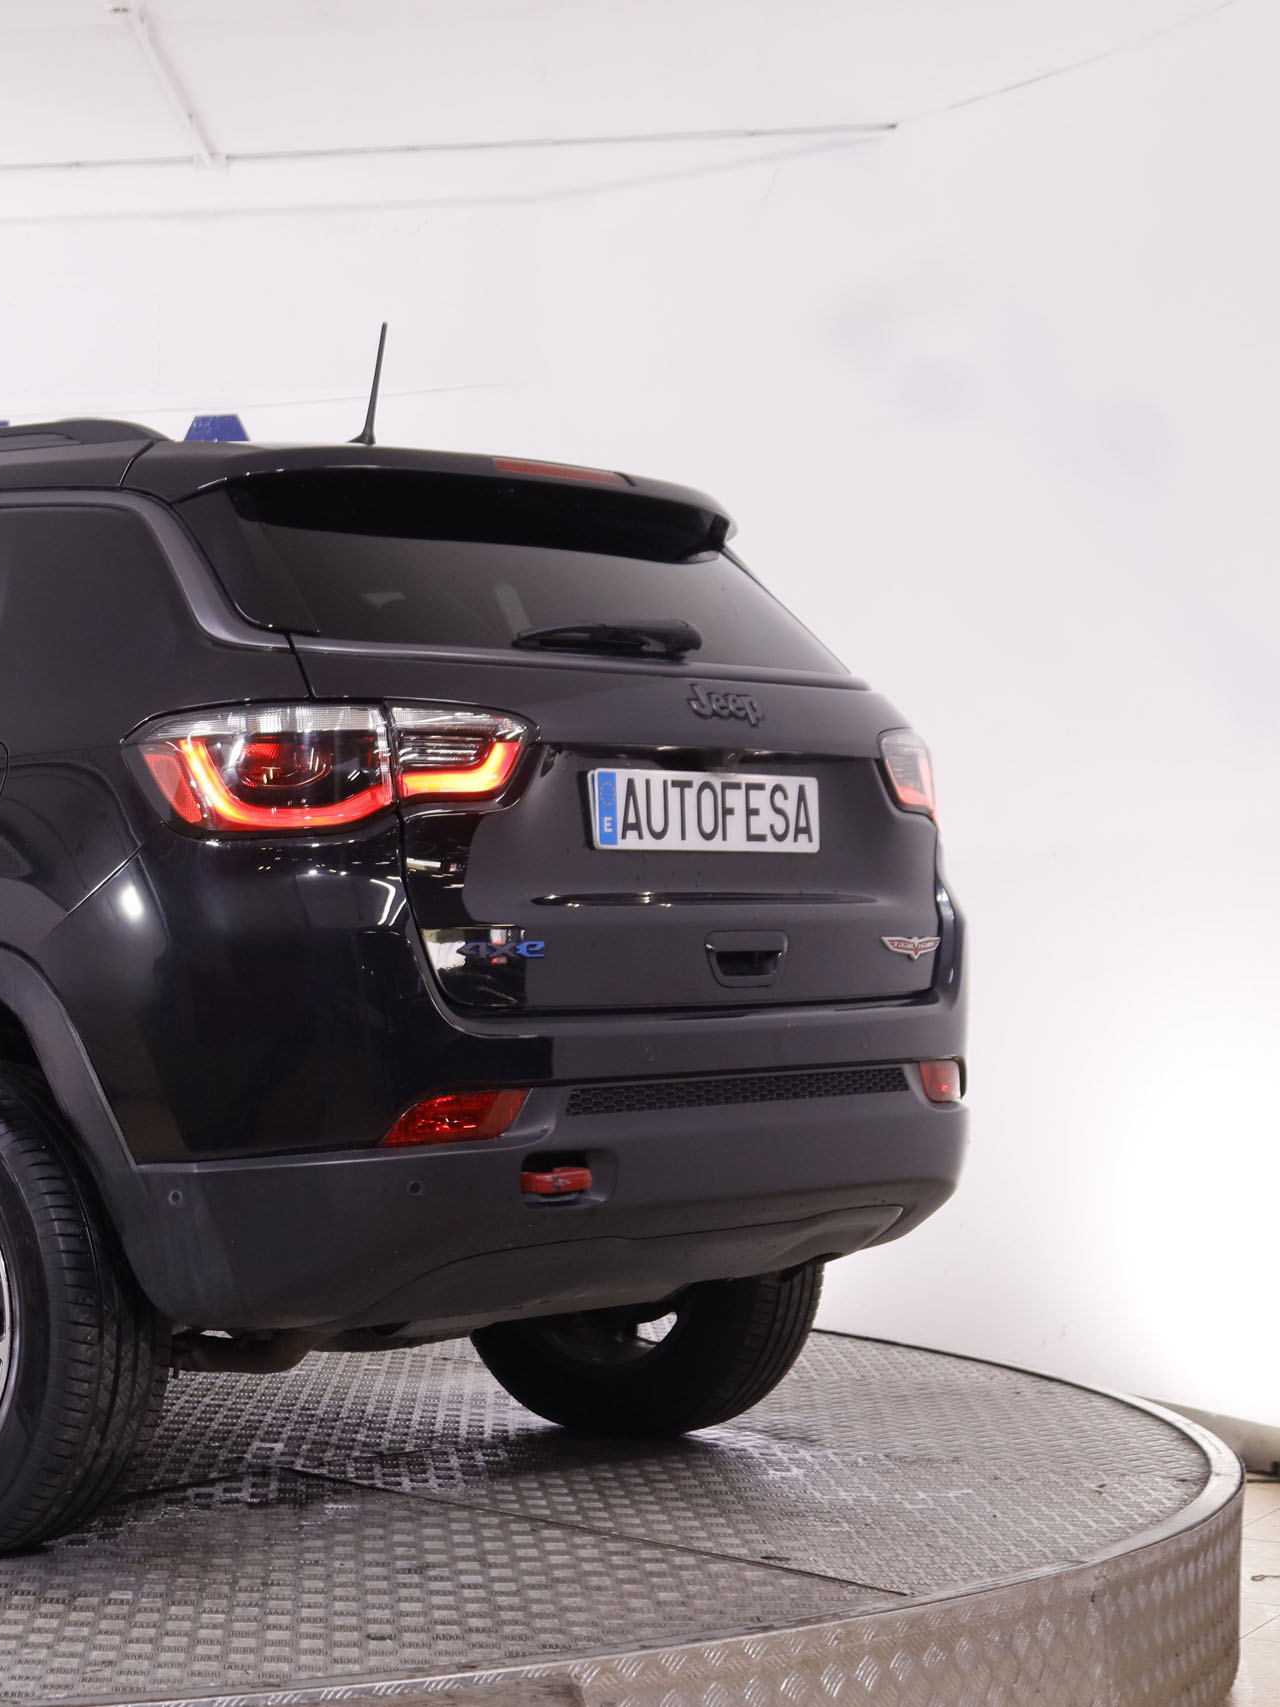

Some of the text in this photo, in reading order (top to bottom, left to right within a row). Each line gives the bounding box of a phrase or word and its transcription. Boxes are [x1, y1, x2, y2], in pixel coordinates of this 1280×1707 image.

[686, 682, 765, 728] Jeep
[603, 816, 613, 833] E
[621, 777, 813, 843] AUTOFESA
